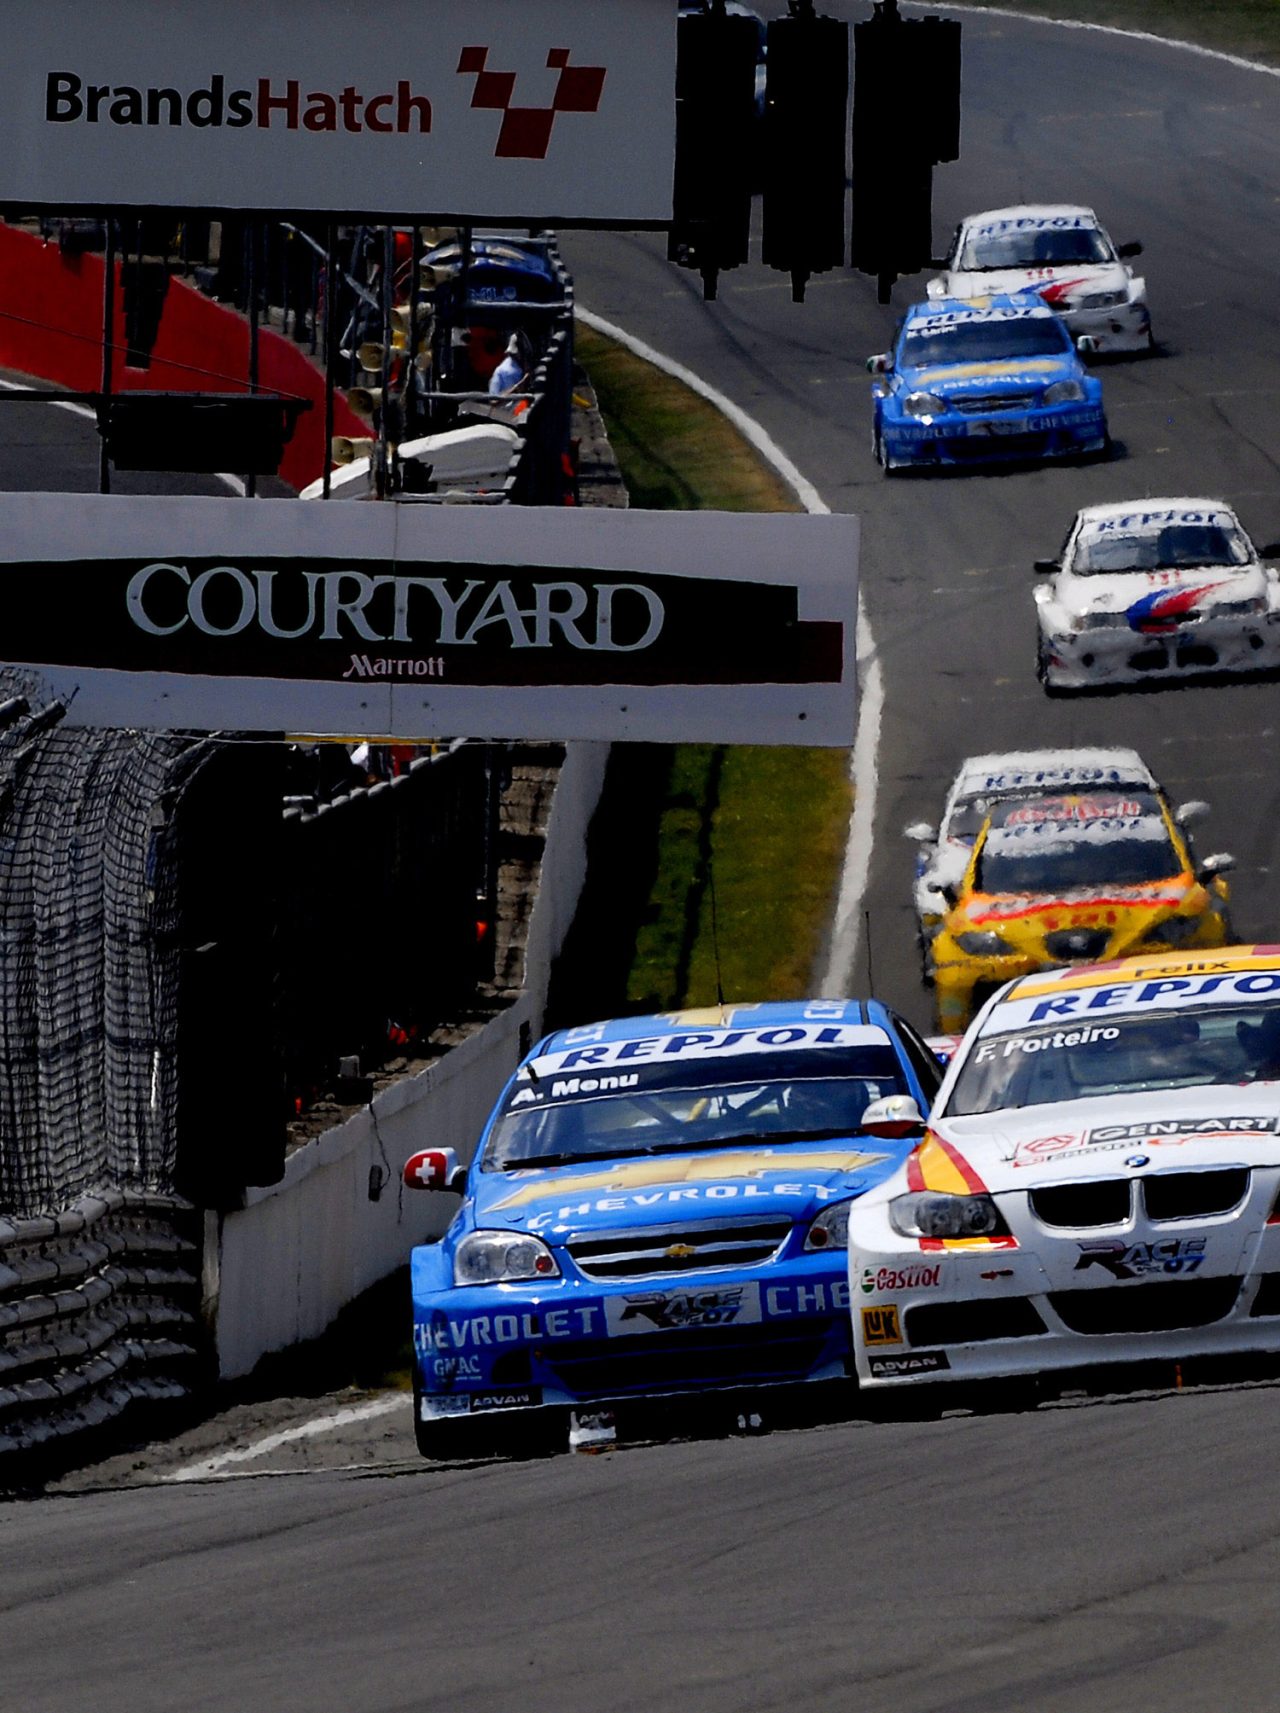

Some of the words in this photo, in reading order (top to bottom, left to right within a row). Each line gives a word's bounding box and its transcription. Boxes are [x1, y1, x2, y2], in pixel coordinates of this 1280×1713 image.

[45, 71, 432, 133] BrandsHatch
[126, 562, 665, 653] COURTYARD
[343, 652, 446, 678] Marriott
[559, 1027, 846, 1069] REPSOL
[1003, 1025, 1120, 1058] Porteiro
[510, 1086, 545, 1106] A.
[1092, 1117, 1275, 1143] GEN-ART
[526, 1182, 838, 1231] CHEVROLET
[877, 1264, 942, 1291] Castrol
[872, 1357, 938, 1372] ADVAN
